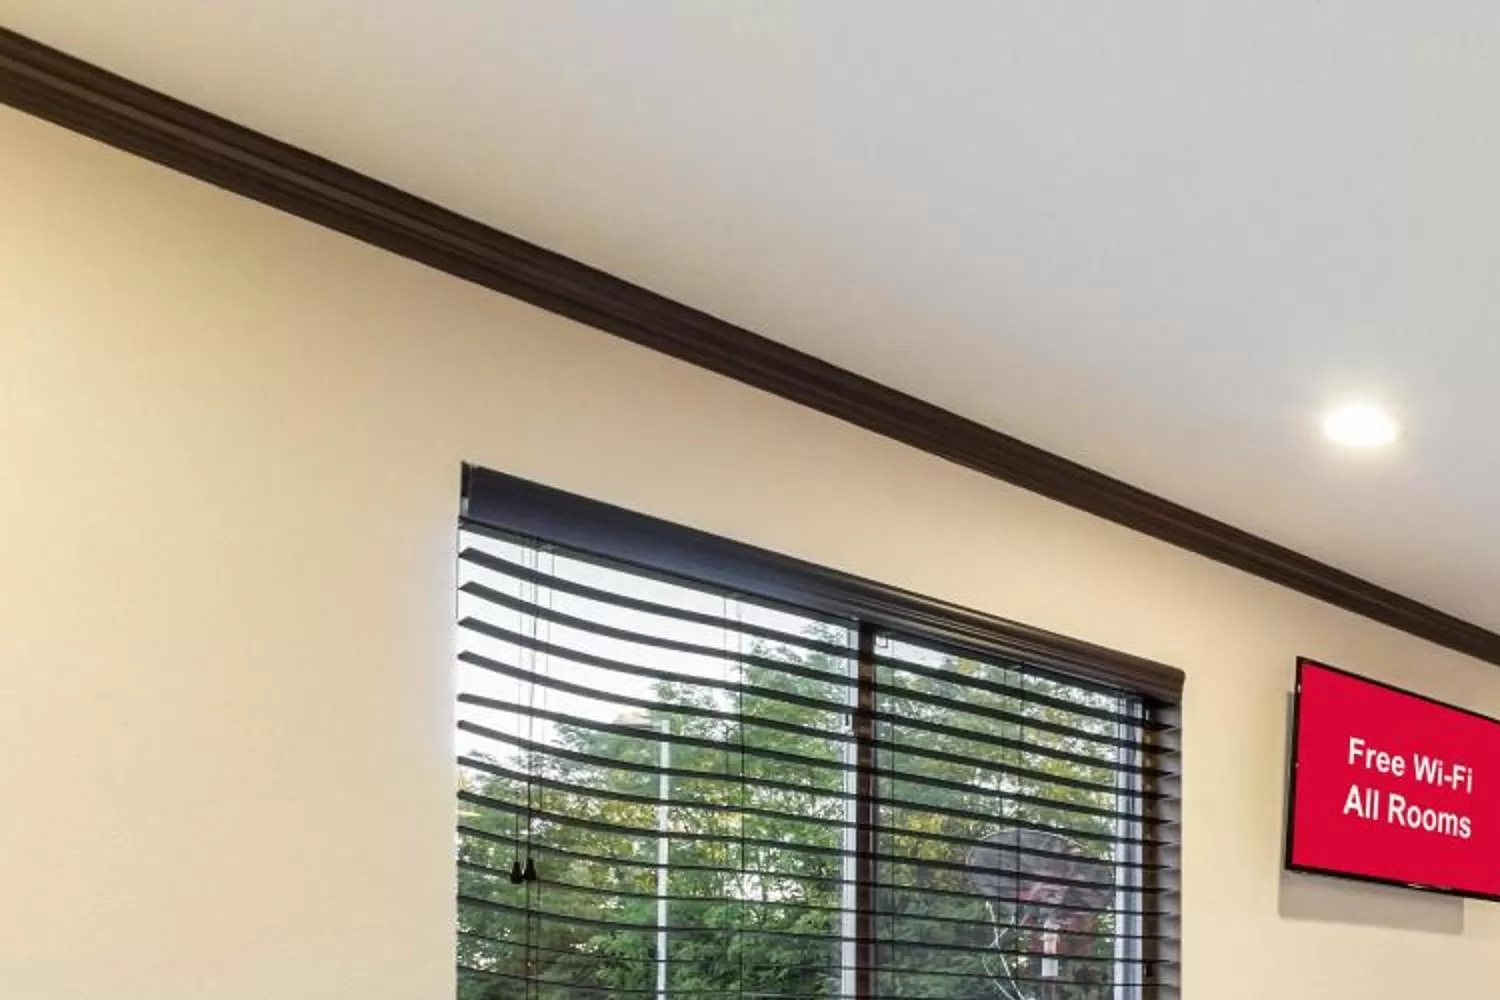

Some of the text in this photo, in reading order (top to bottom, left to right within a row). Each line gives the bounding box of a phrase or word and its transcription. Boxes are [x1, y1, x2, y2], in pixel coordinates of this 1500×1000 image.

[1347, 736, 1473, 793] Free Wi-Fi
[1343, 784, 1472, 839] All Rooms
